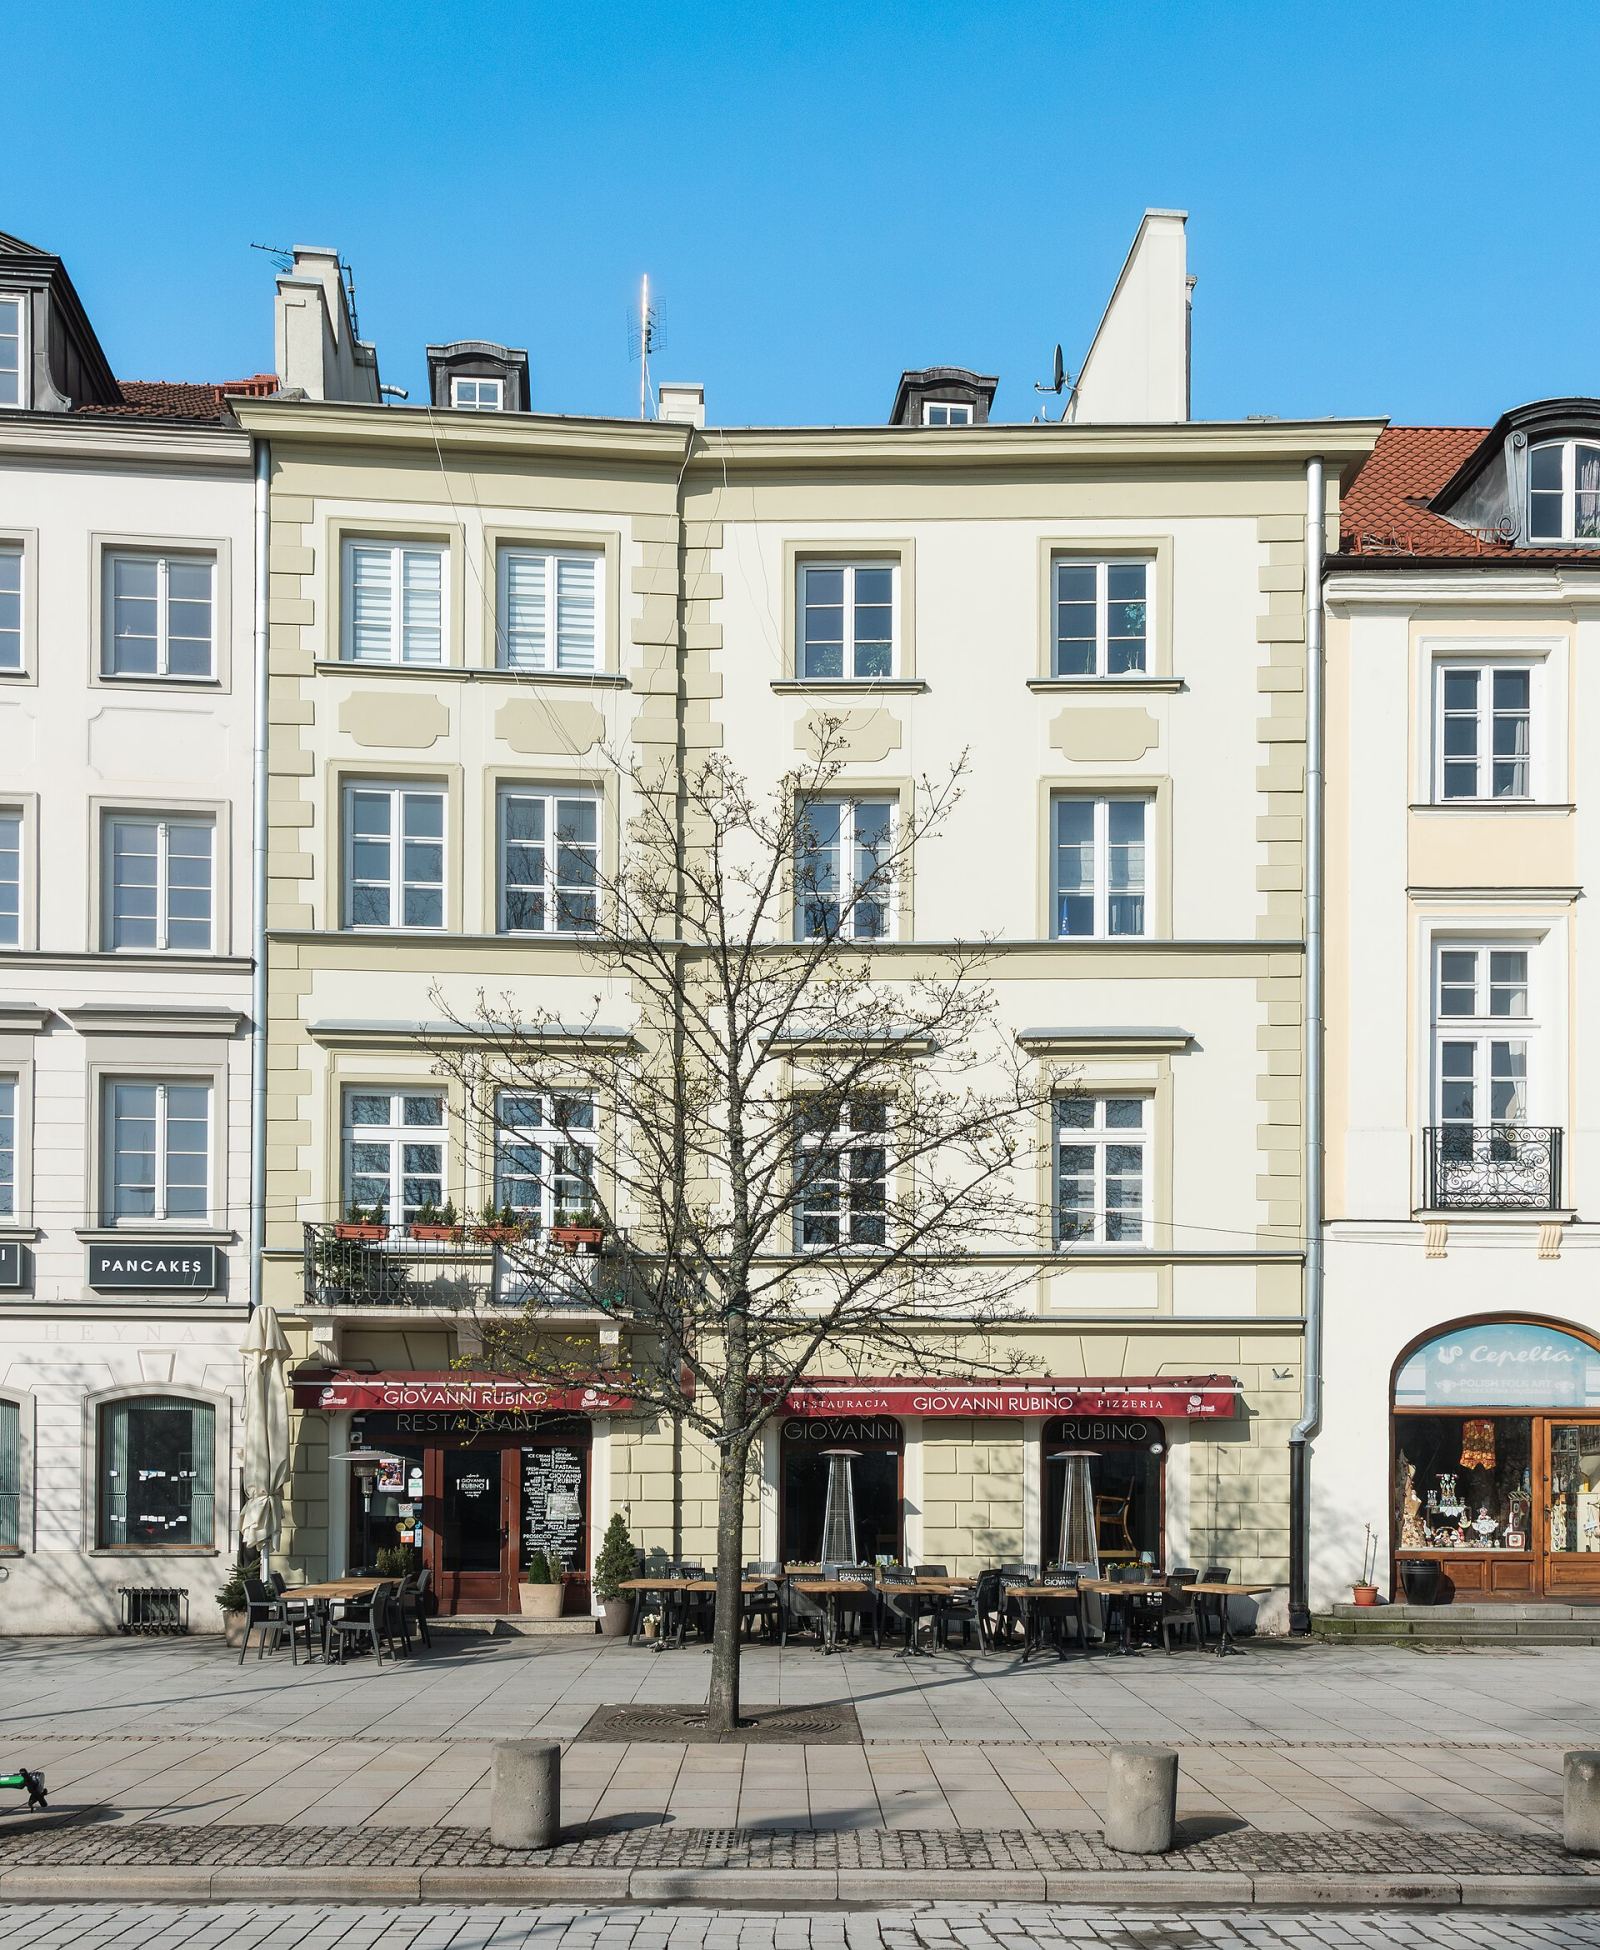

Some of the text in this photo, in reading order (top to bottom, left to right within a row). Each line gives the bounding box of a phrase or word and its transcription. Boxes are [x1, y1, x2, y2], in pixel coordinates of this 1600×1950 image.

[101, 1259, 202, 1273] PANCAKES
[1469, 1344, 1575, 1367] Cepelia
[384, 1390, 548, 1405] GIOVANNI RUBINO
[792, 1399, 888, 1409] RESTAURACJA
[913, 1397, 1073, 1410] GIOVANNI RUBINO
[1097, 1400, 1164, 1409] PIZZERIA
[784, 1422, 898, 1440] GIOVANNI
[1062, 1423, 1147, 1440] RUBINO
